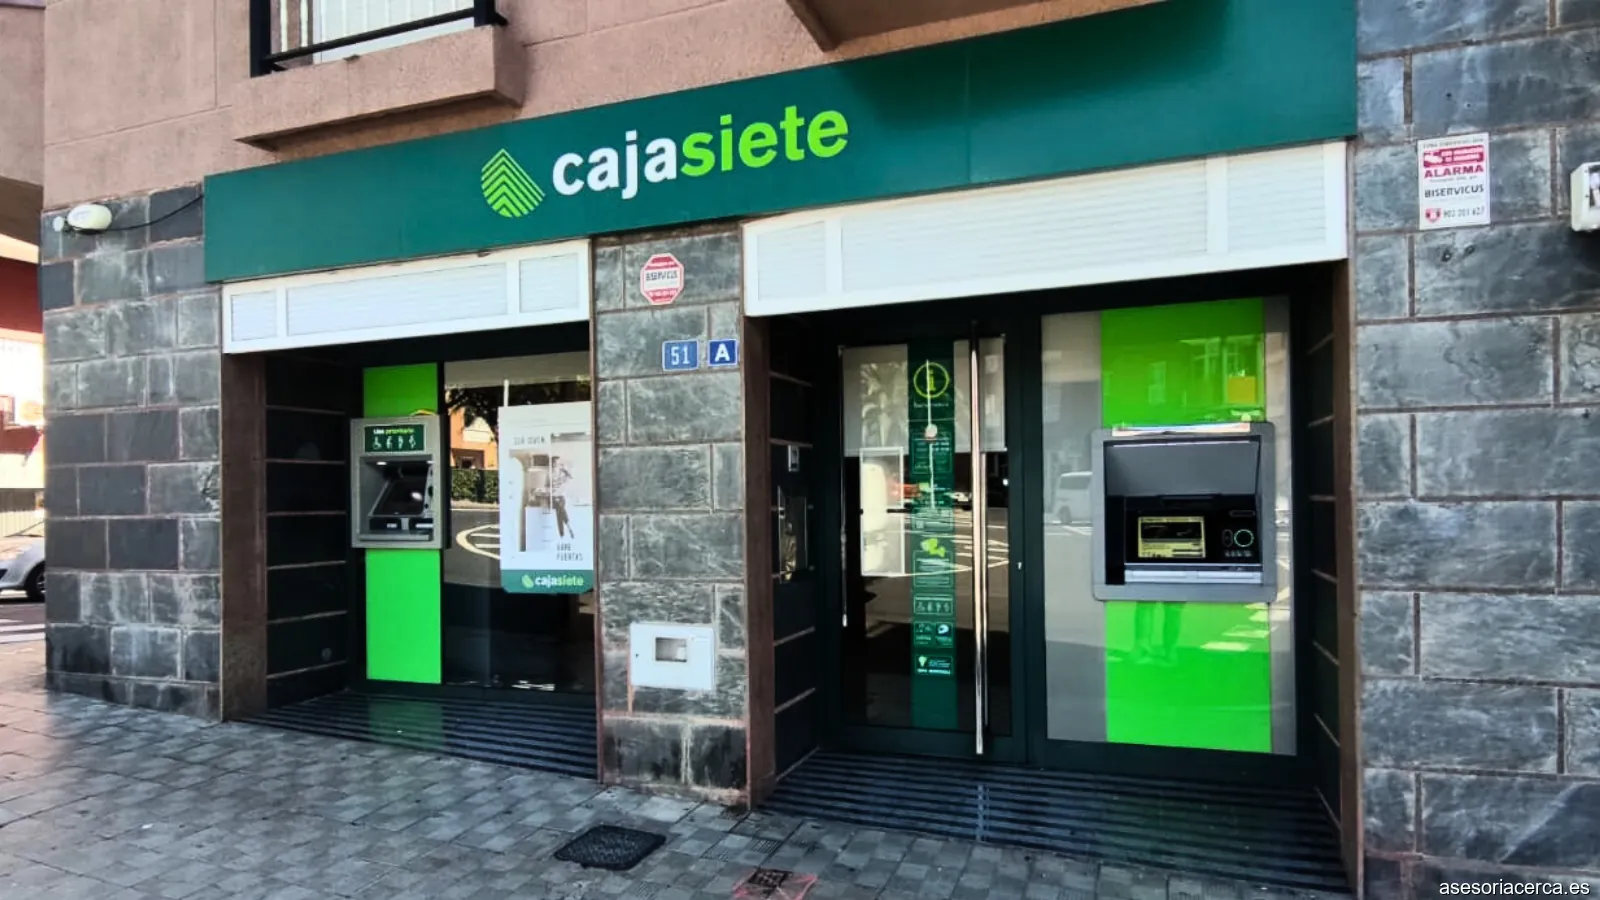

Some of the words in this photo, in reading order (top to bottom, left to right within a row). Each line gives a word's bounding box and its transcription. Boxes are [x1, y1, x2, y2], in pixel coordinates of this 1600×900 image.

[552, 105, 849, 200] cajasiete
[1424, 165, 1484, 178] ALARMA
[1424, 184, 1484, 198] BISERVICUS
[670, 346, 690, 365] 51
[714, 343, 730, 362] A
[534, 574, 584, 588] cajasiete
